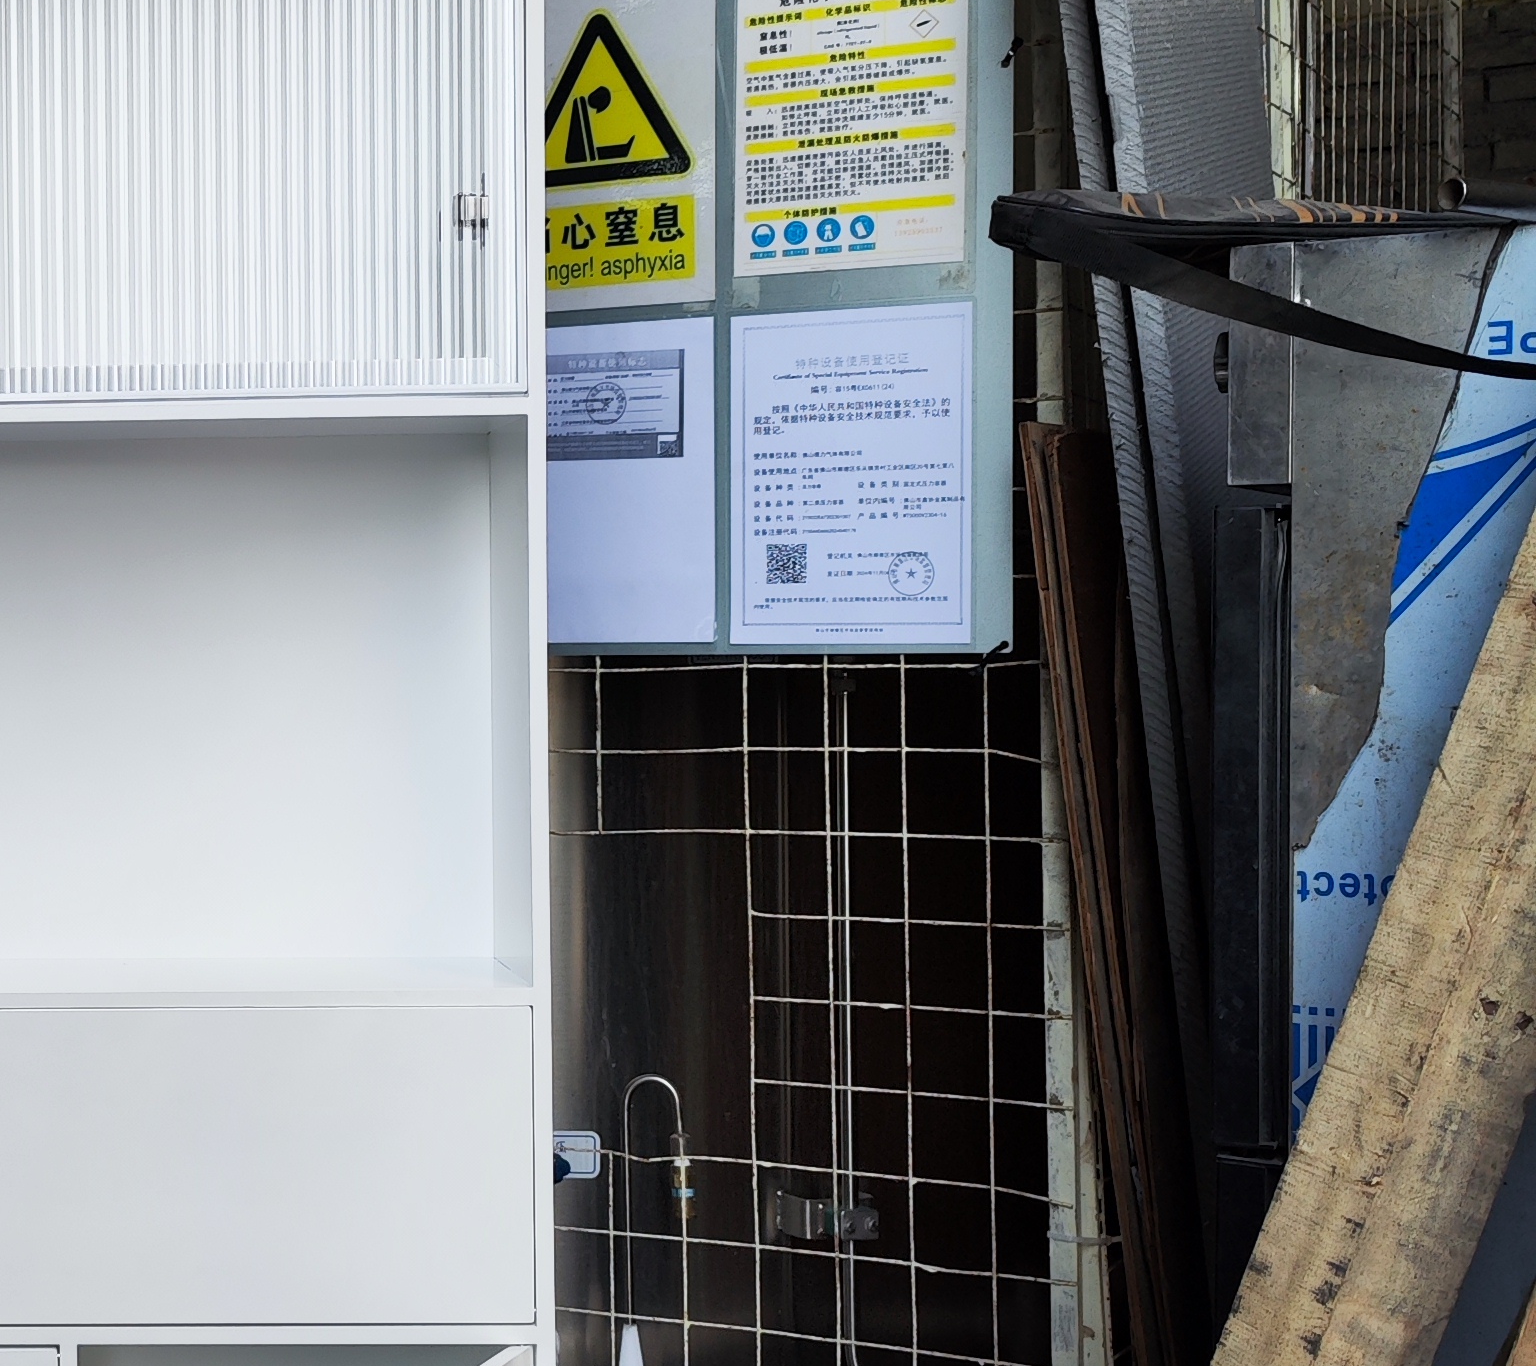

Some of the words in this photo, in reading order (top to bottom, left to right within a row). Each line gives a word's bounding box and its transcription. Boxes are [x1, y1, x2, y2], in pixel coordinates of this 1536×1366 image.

[545, 203, 685, 254] 心窒息
[545, 256, 593, 285] nger!
[601, 249, 685, 279] asphyxia
